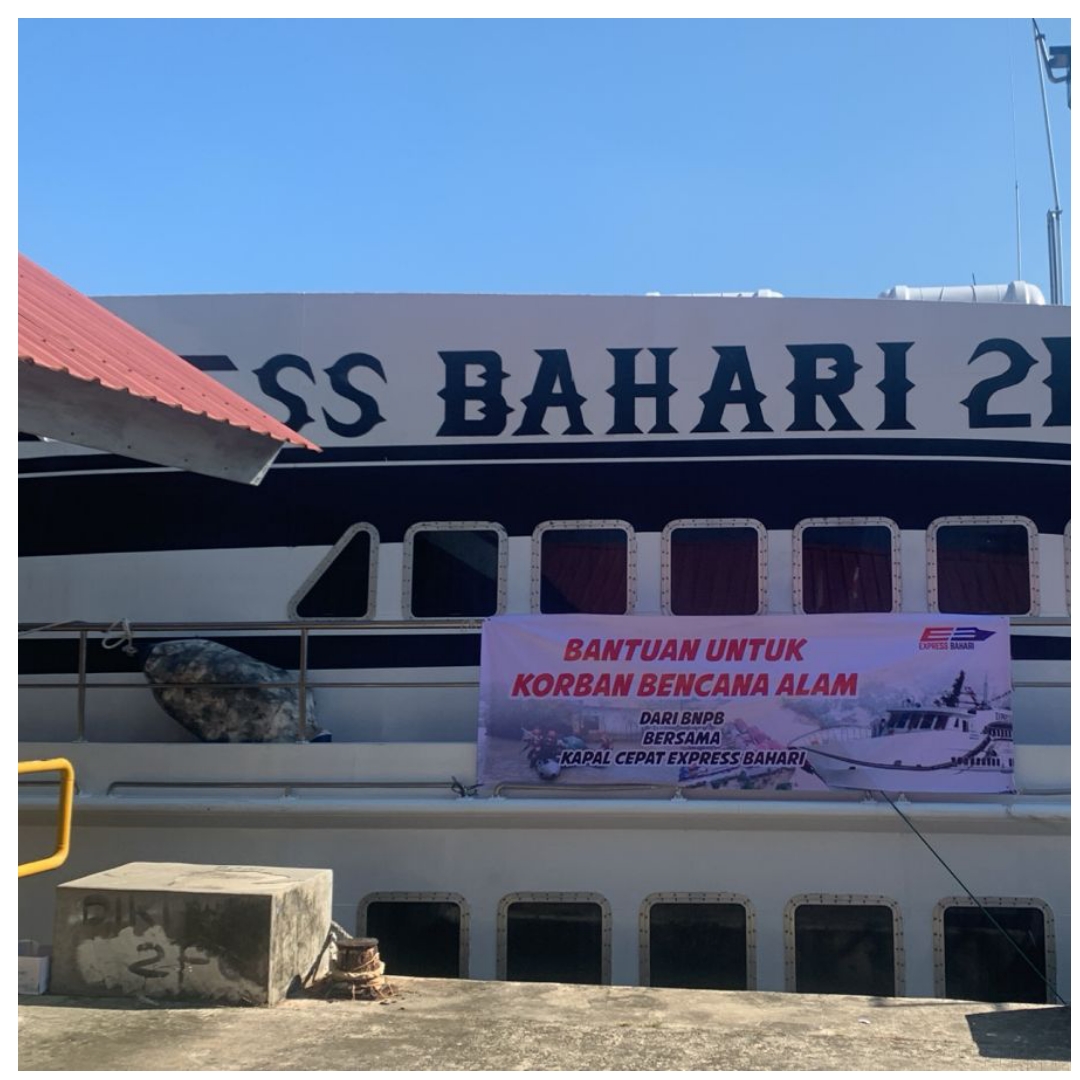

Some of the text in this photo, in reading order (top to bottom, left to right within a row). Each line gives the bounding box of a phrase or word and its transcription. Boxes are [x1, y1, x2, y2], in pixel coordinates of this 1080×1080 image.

[436, 341, 917, 437] BAHARI
[563, 638, 807, 661] BANTUAN UNTUK
[950, 642, 975, 650] BAHARI
[511, 672, 858, 697] KORBAN BENCANA ALAM
[639, 711, 725, 725] DARI BNPB
[642, 731, 721, 746] BERSAMA
[560, 751, 806, 766] KAPAL CEPAT EXPRESS BAHARI
